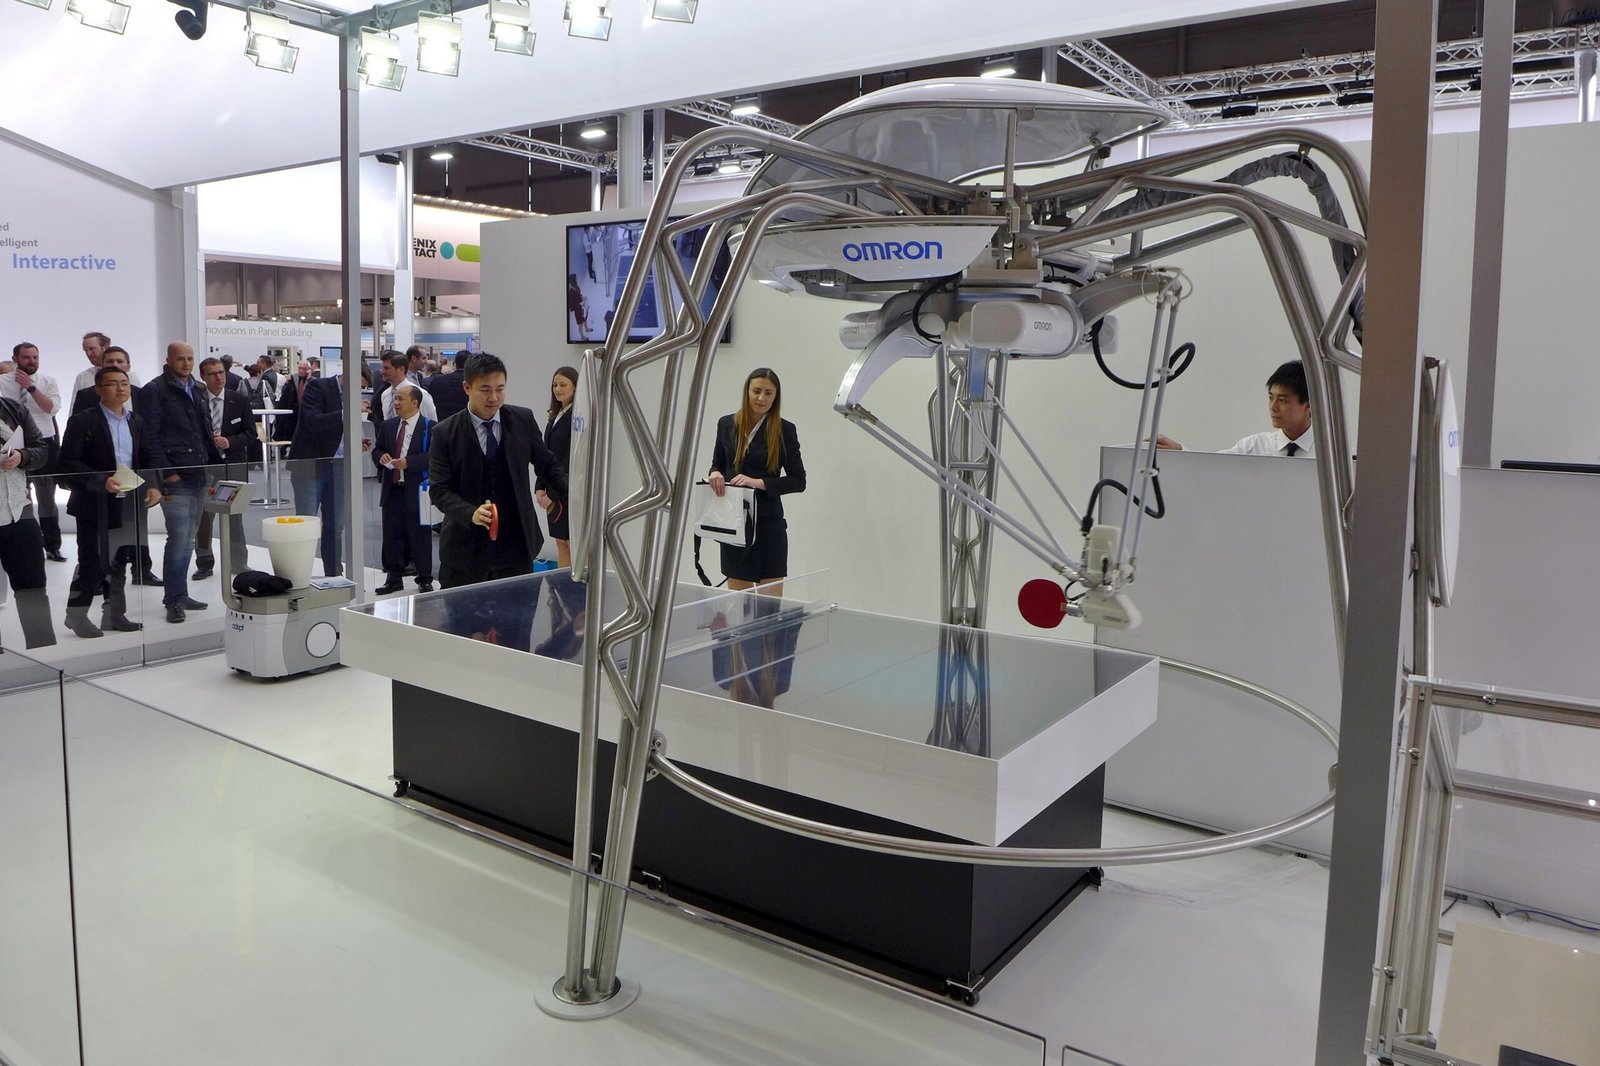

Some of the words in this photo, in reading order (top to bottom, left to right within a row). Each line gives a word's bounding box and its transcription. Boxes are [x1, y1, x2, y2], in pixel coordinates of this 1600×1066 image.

[413, 247, 437, 259] TACT
[842, 241, 943, 262] OMRON
[12, 253, 117, 271] Interactive
[248, 327, 257, 336] in
[258, 327, 280, 337] Panel
[281, 328, 313, 340] Building
